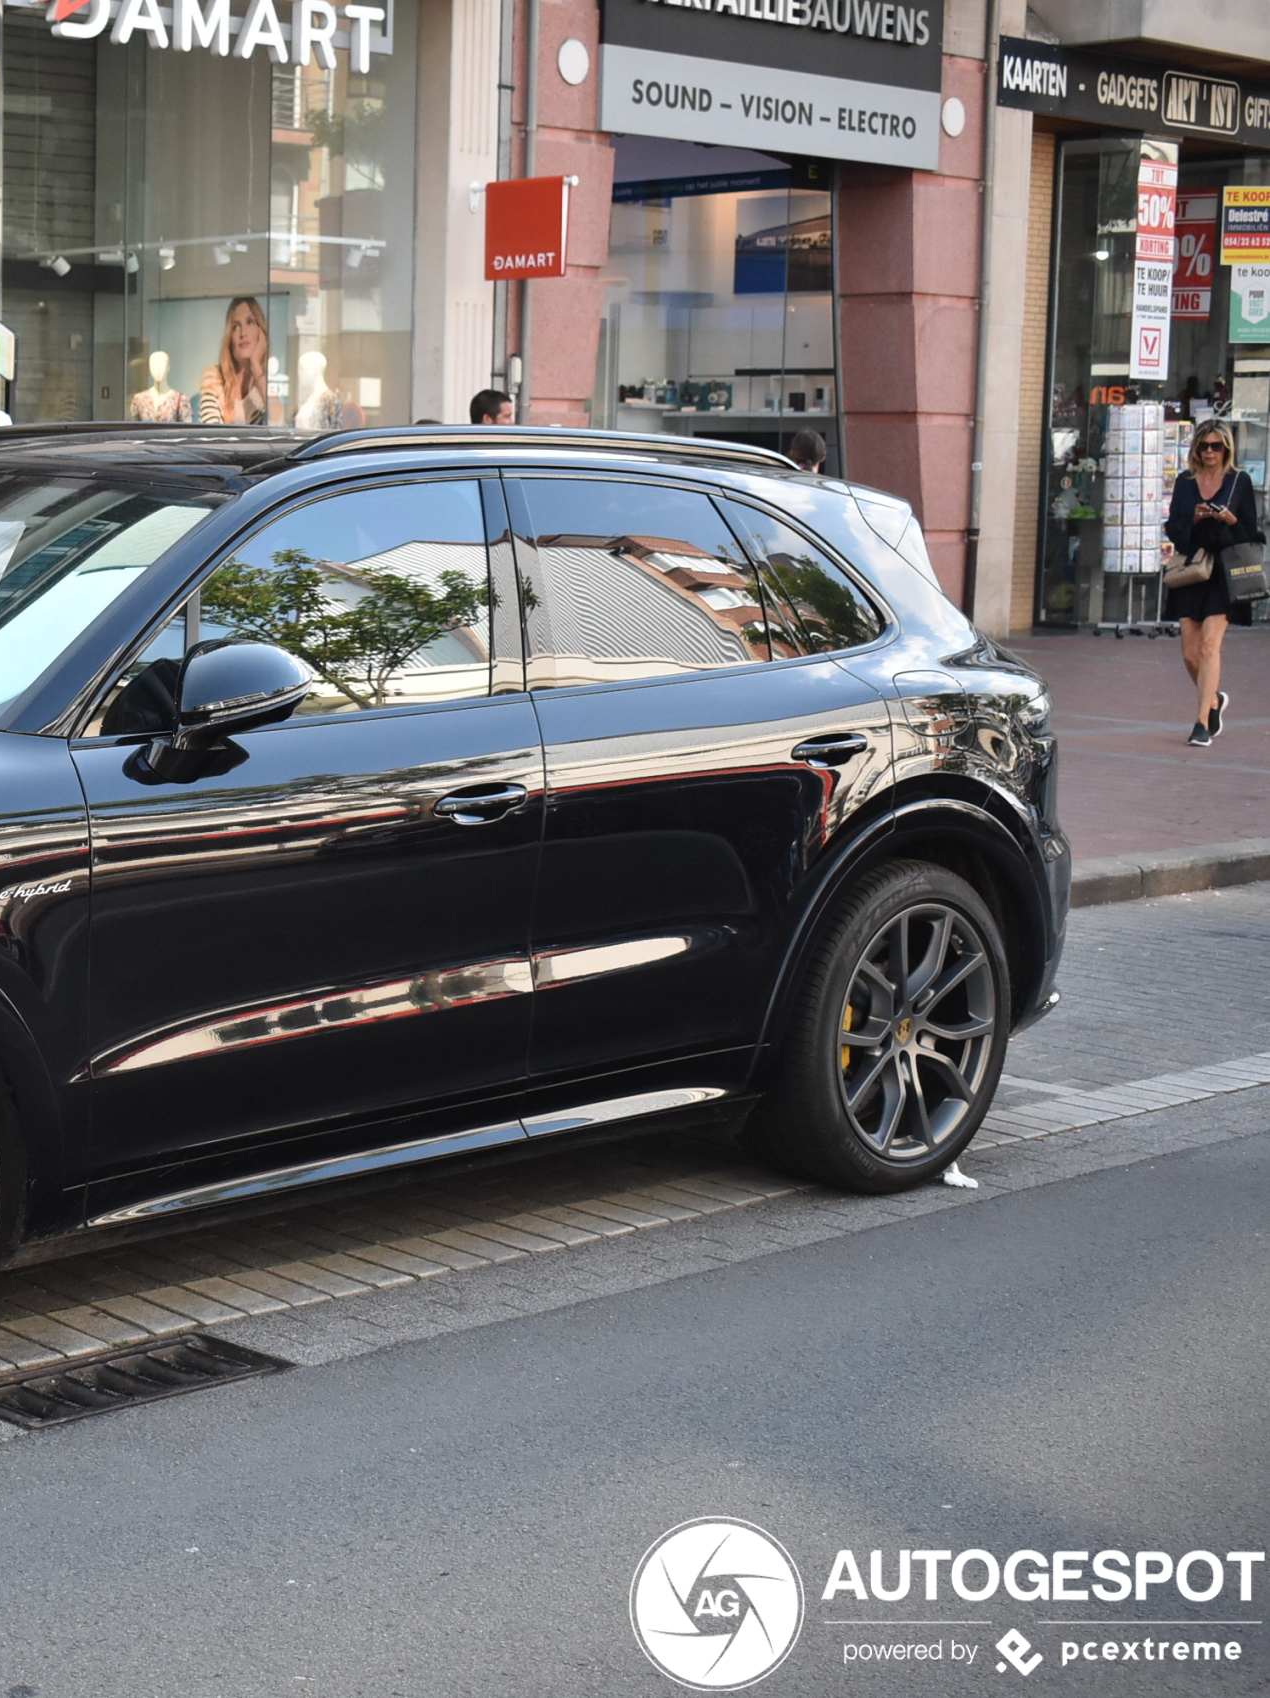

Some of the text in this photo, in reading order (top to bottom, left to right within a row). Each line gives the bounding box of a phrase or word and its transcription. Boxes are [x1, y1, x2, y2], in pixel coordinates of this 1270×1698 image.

[1003, 55, 1067, 98] KAARTEN
[1097, 71, 1158, 112] GADGETS
[632, 79, 712, 112] SOUND
[741, 94, 813, 126] VISION
[837, 107, 917, 140] ELECTRO
[1151, 169, 1165, 183] TOT
[1226, 190, 1239, 202] TE
[1138, 193, 1175, 229] 50%
[1228, 207, 1269, 222] Delestré
[1140, 238, 1169, 254] KORTING
[492, 252, 556, 270] DAMART
[1137, 267, 1145, 279] TE
[1238, 267, 1248, 277] te
[1137, 283, 1168, 297] TE HUUR
[0, 879, 72, 904] e-hybrid
